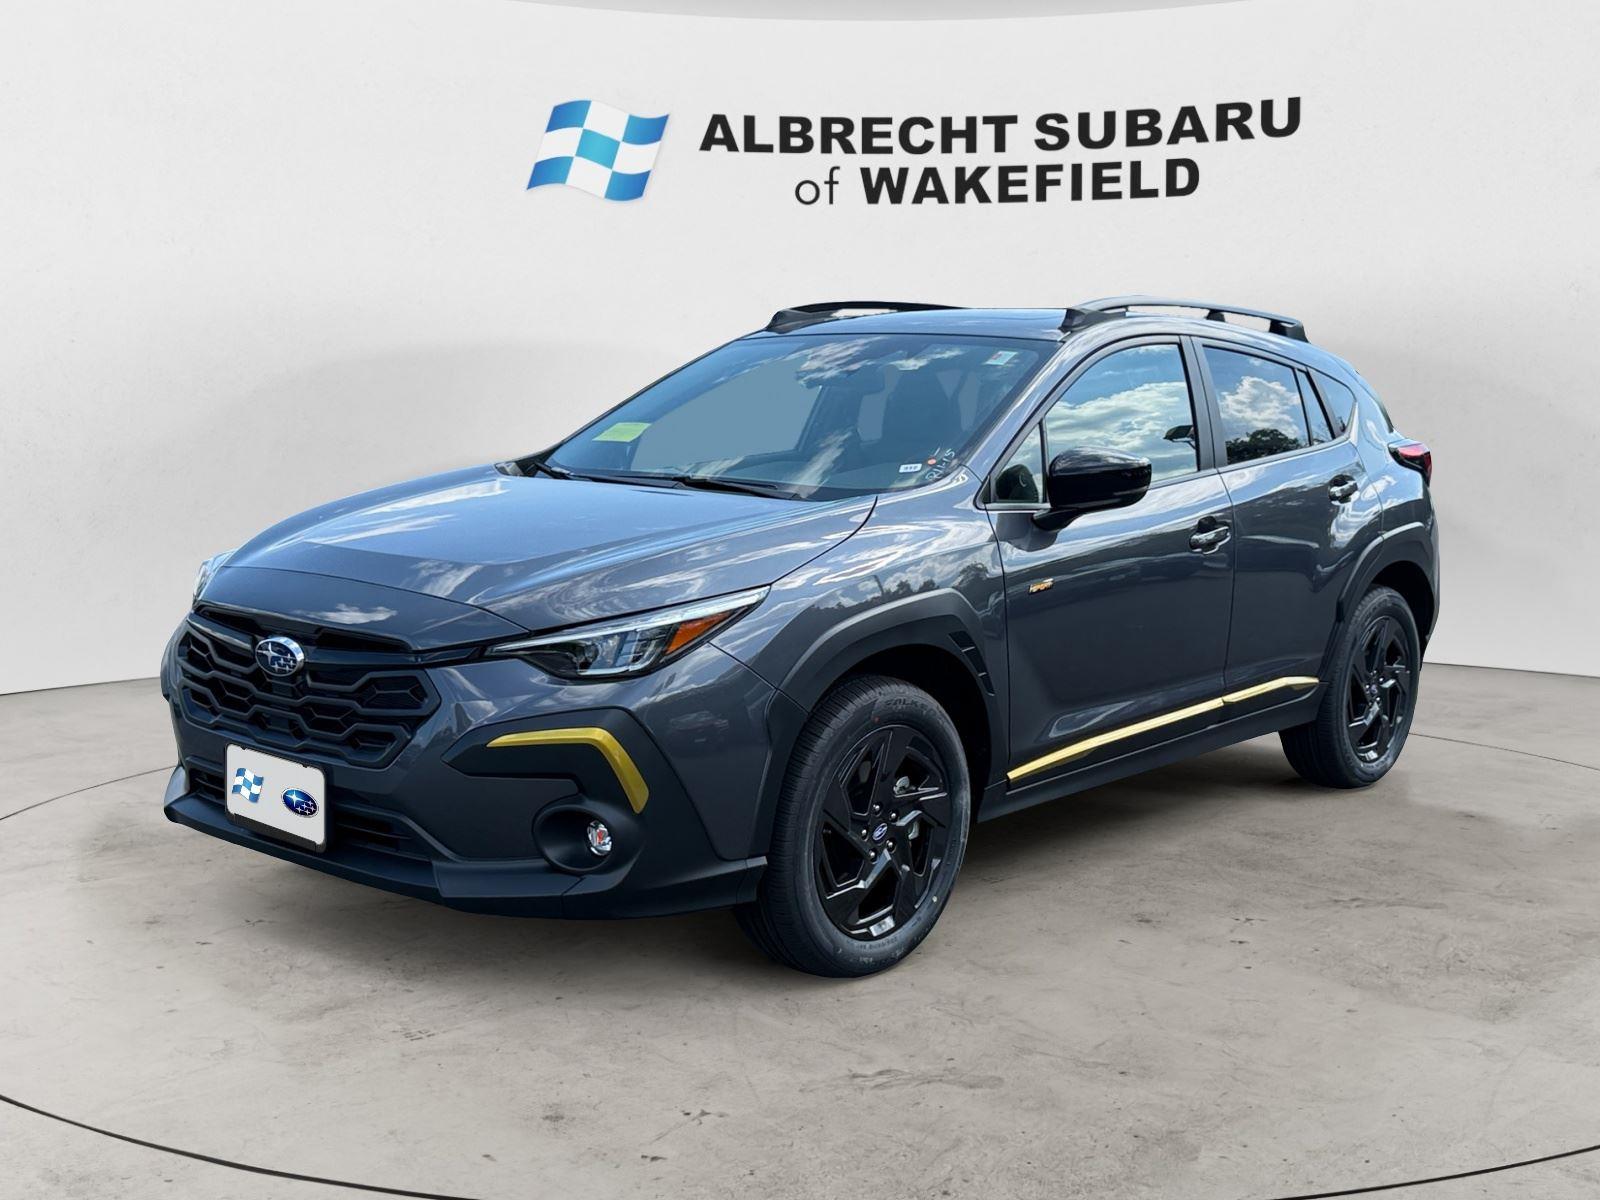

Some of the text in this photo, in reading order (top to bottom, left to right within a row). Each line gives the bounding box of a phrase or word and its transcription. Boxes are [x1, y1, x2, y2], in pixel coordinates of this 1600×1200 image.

[699, 96, 1302, 155] ALBRECHT SUBARU
[794, 157, 1200, 206] of WAKEFIELD
